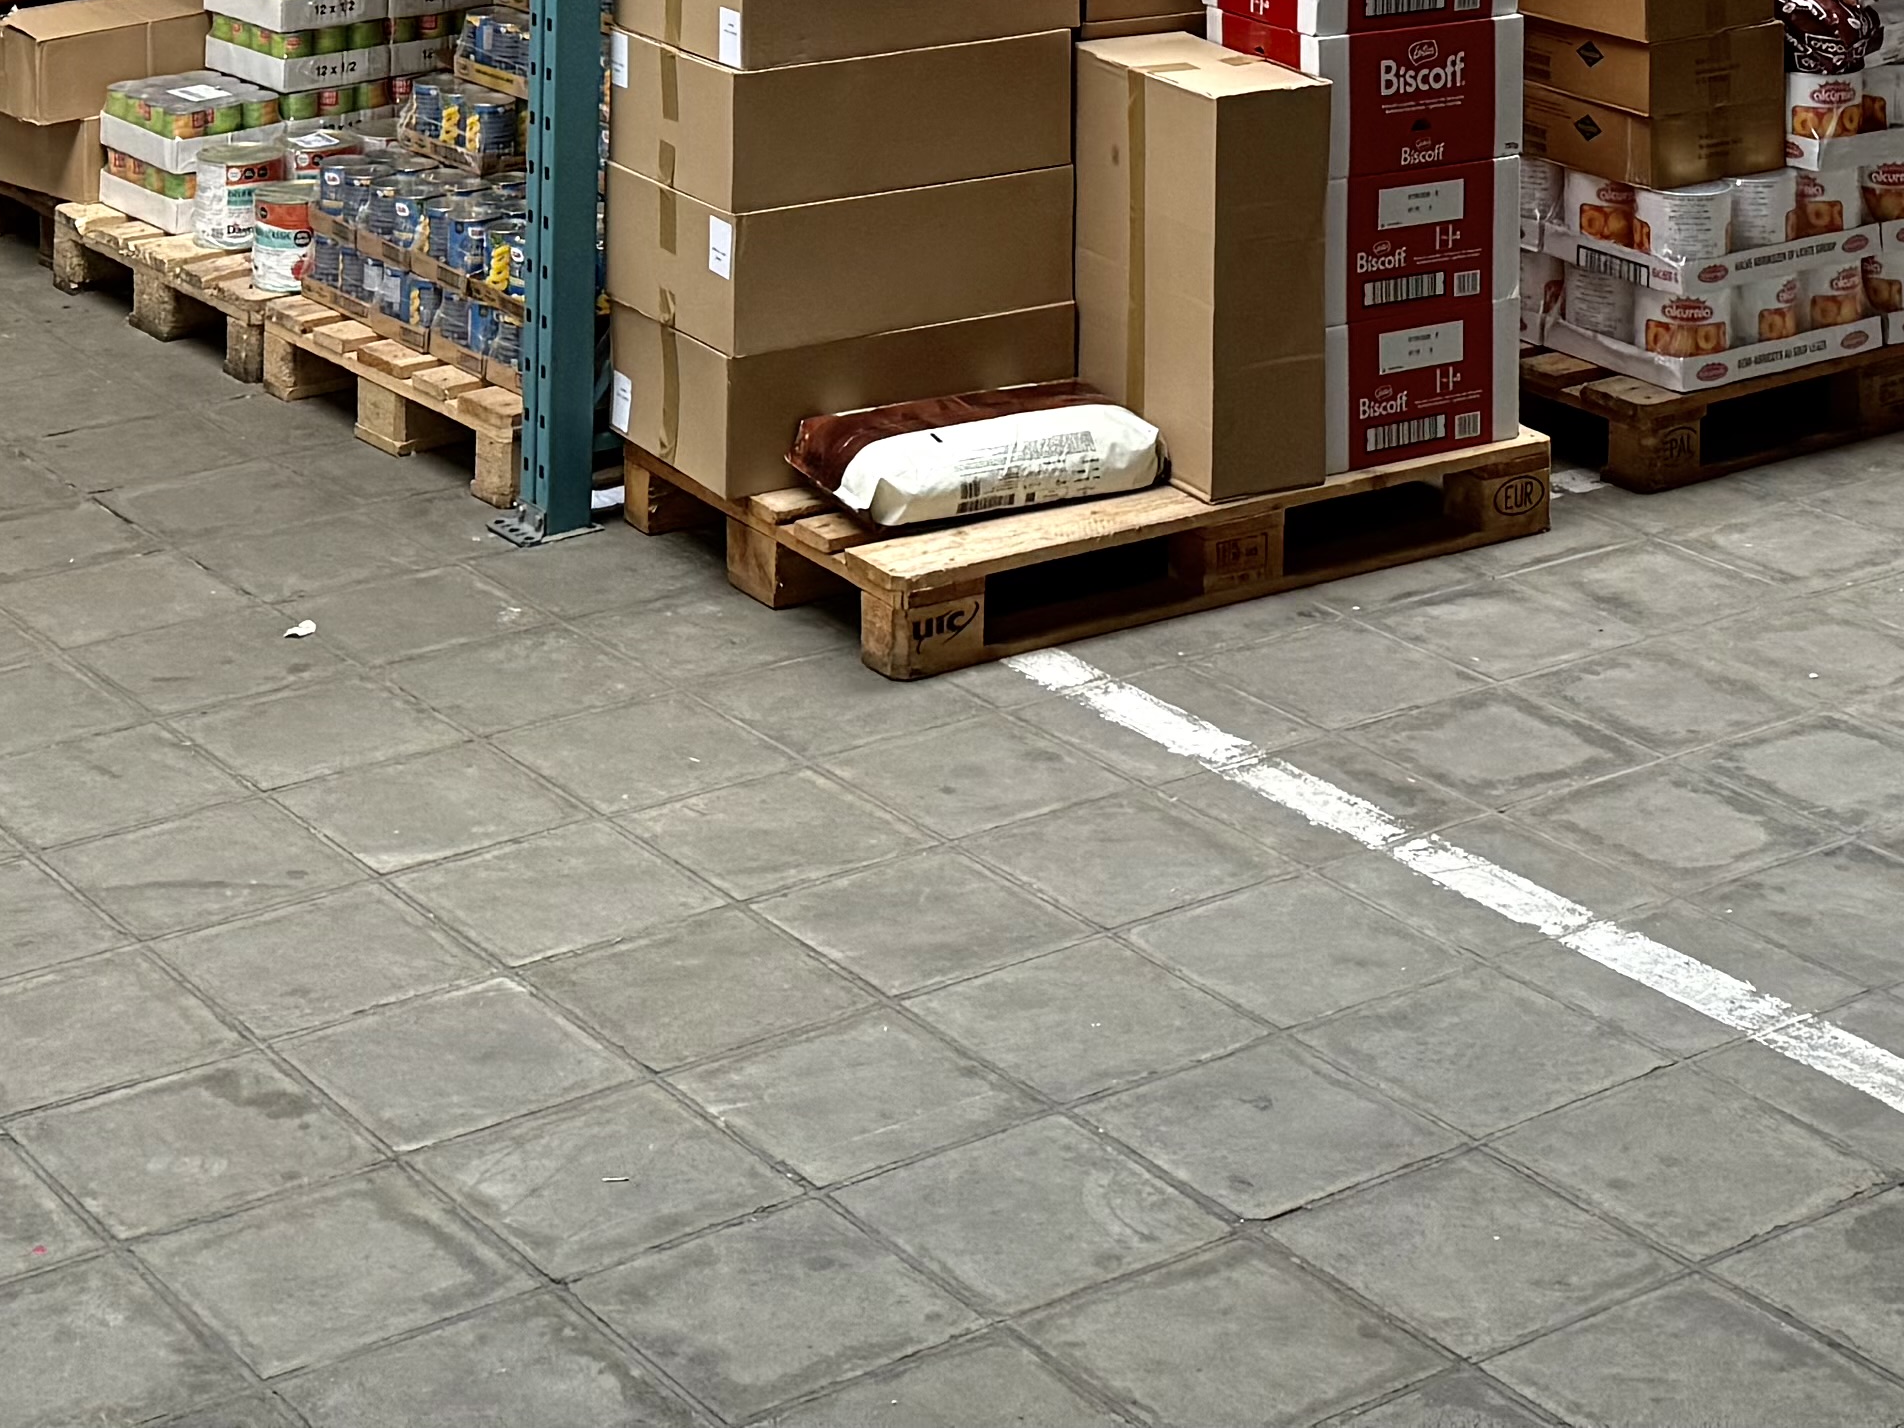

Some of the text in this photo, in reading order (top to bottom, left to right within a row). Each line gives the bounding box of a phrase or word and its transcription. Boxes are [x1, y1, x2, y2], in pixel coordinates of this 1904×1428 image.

[1380, 51, 1465, 97] Biscoff
[1400, 142, 1445, 165] Biscoff
[1357, 247, 1407, 273] Biscoff
[1359, 390, 1408, 420] Biscoff
[1504, 487, 1534, 511] EUR
